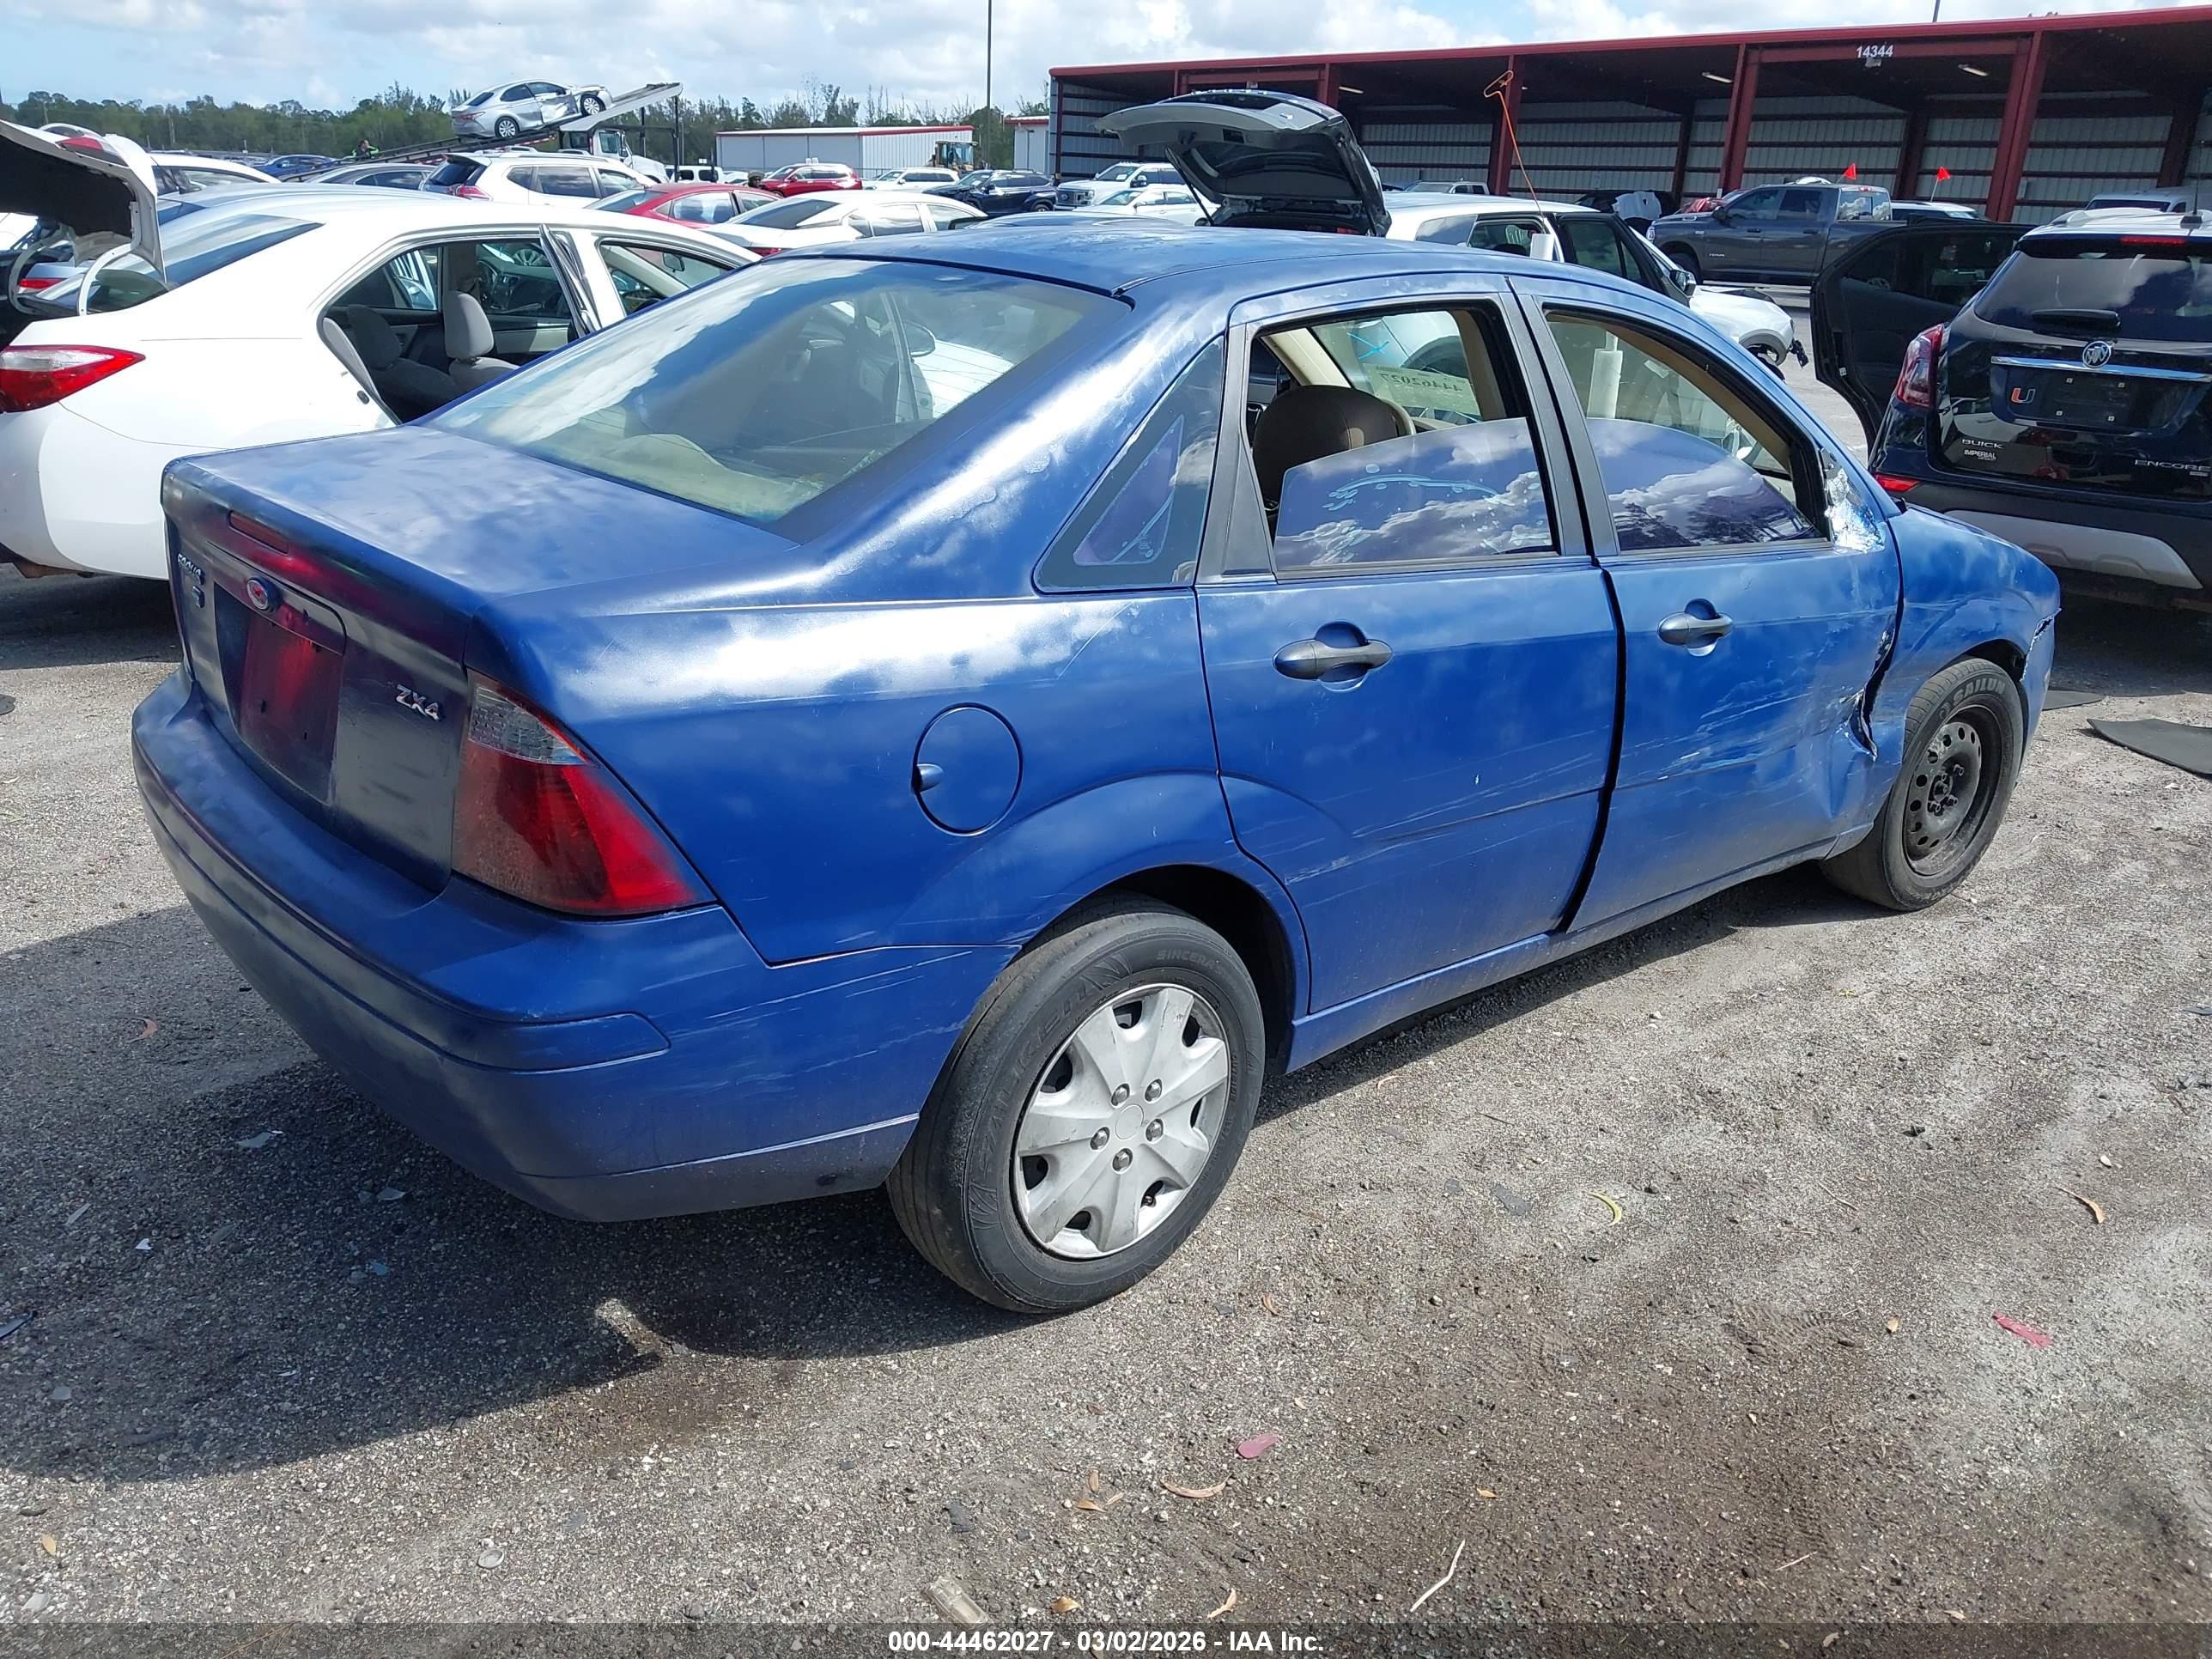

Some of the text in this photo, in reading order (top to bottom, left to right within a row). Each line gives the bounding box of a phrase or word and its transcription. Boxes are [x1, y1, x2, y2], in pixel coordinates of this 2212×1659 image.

[1856, 45, 1894, 58] 14344
[1961, 439, 2004, 449] BUICK
[1964, 449, 1997, 460] IMPERIAL
[2135, 459, 2212, 472] ENCORE
[1952, 678, 2007, 707] SAILUN
[396, 684, 440, 721] ZX4
[1155, 949, 1214, 969] SINCERA
